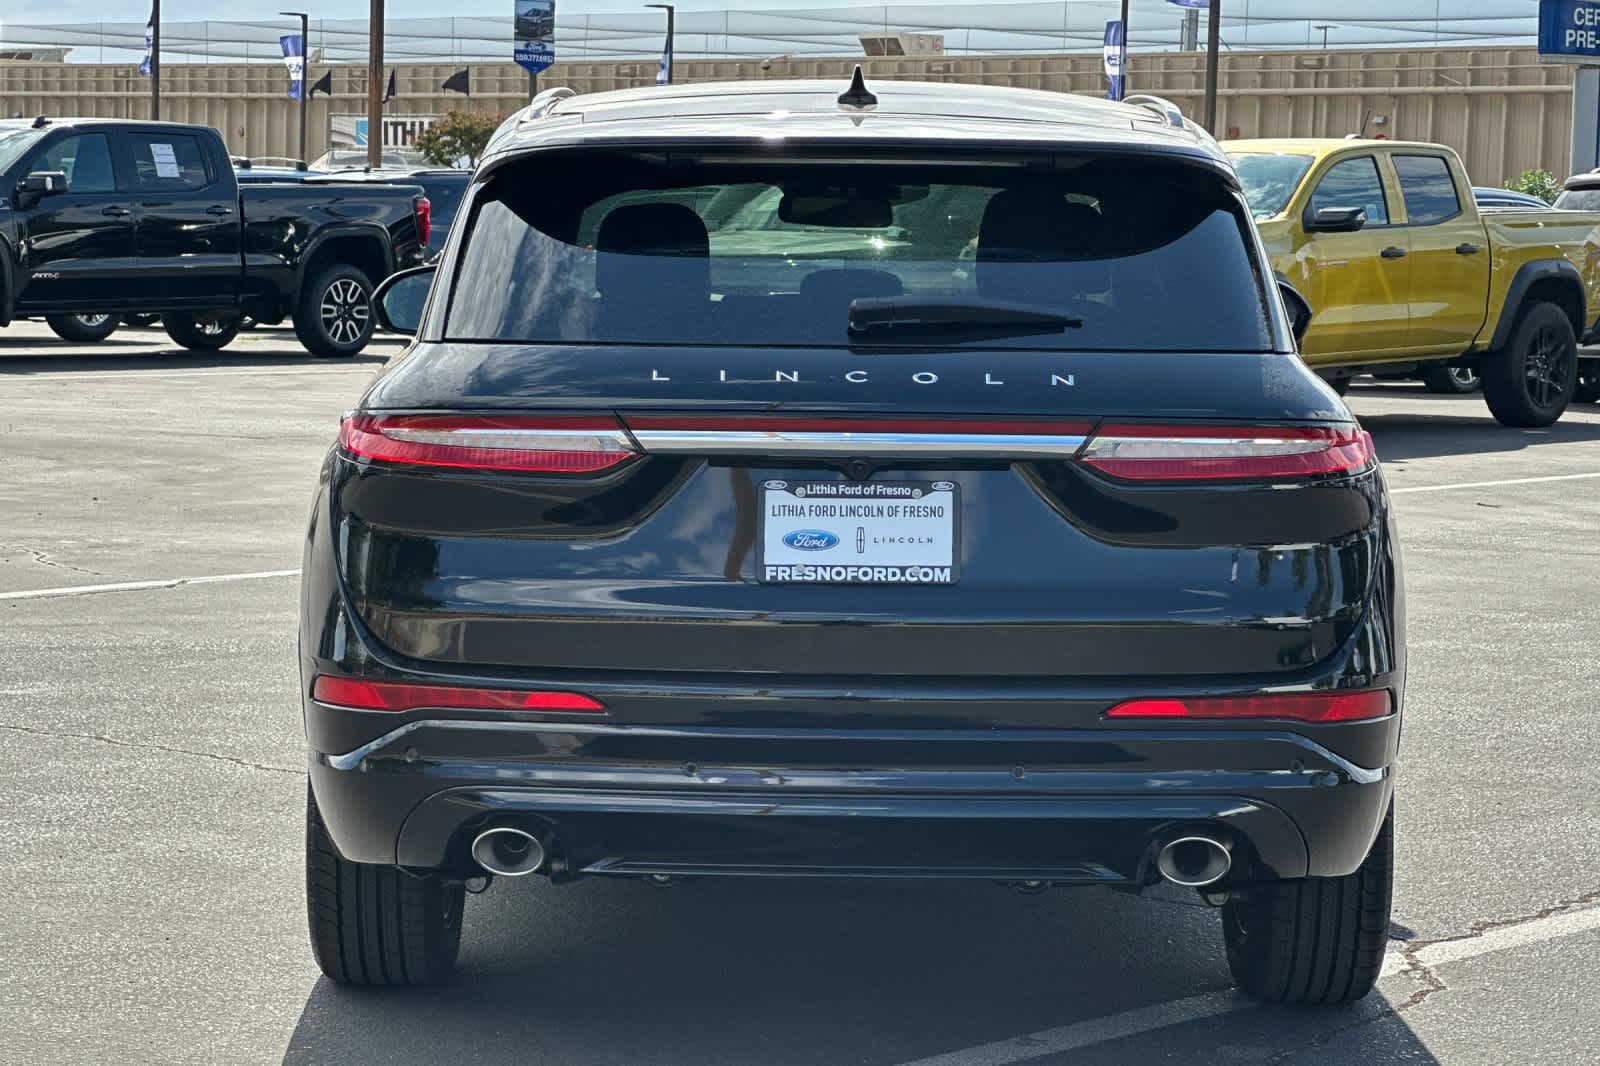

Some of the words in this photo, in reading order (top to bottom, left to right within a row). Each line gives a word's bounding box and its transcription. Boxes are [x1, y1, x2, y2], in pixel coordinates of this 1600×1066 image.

[652, 369, 1075, 386] LINCOLN
[806, 484, 837, 495] Lithia
[838, 485, 862, 495] Ford
[863, 485, 875, 495] of
[876, 485, 911, 496] Fresno
[771, 504, 806, 517] LITHIA
[809, 505, 837, 517] FORD
[839, 505, 884, 518] LINCOLN
[887, 505, 901, 518] OF
[903, 505, 944, 518] FRESNO
[793, 532, 828, 548] Ford
[765, 566, 951, 582] FRESNOFORD.COM
